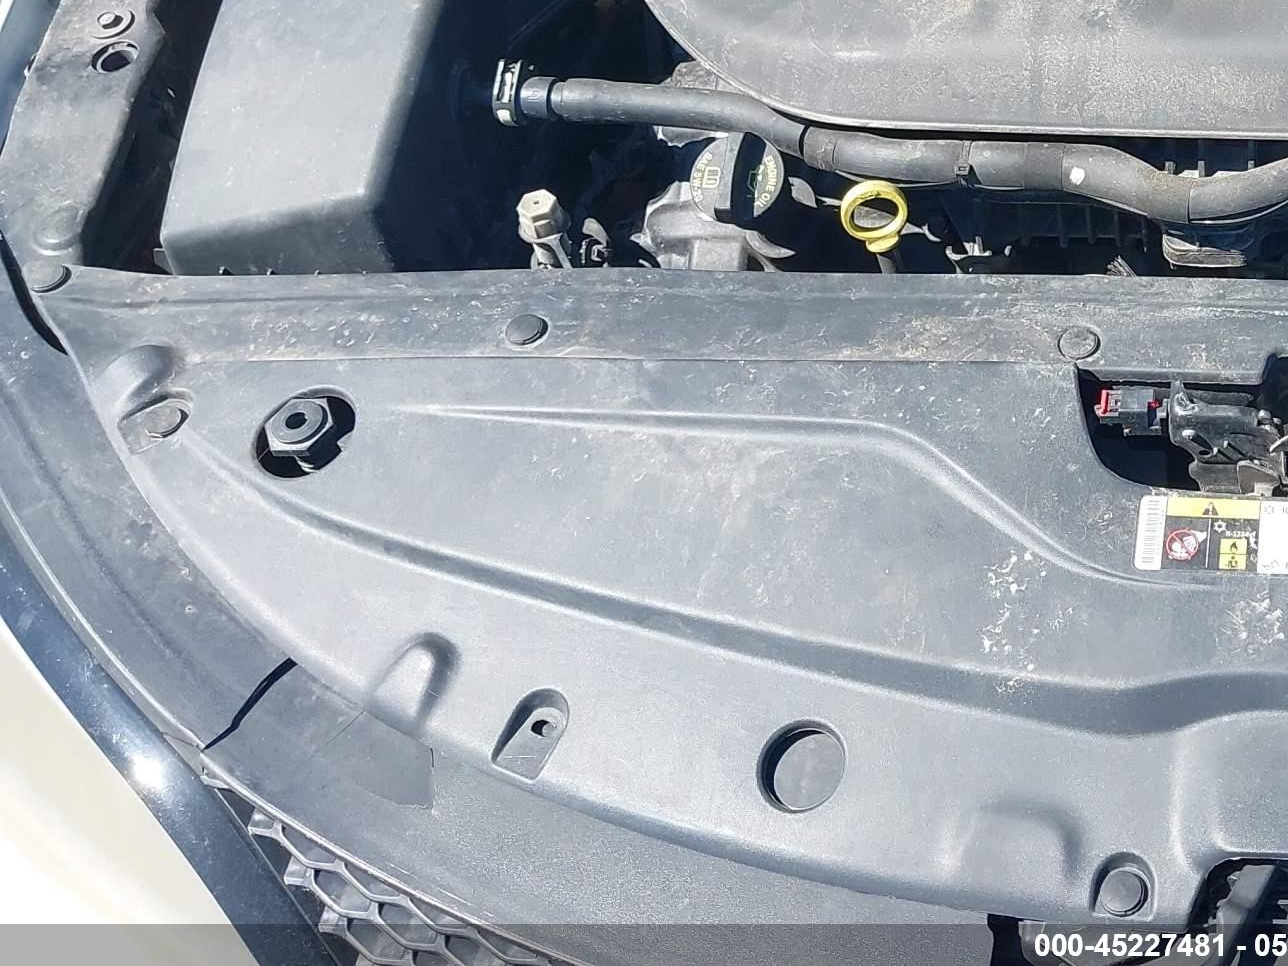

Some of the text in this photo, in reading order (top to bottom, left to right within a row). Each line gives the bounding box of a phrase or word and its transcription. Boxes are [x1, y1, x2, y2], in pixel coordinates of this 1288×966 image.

[696, 152, 713, 171] SAE
[755, 155, 778, 208] ENGINE OIL
